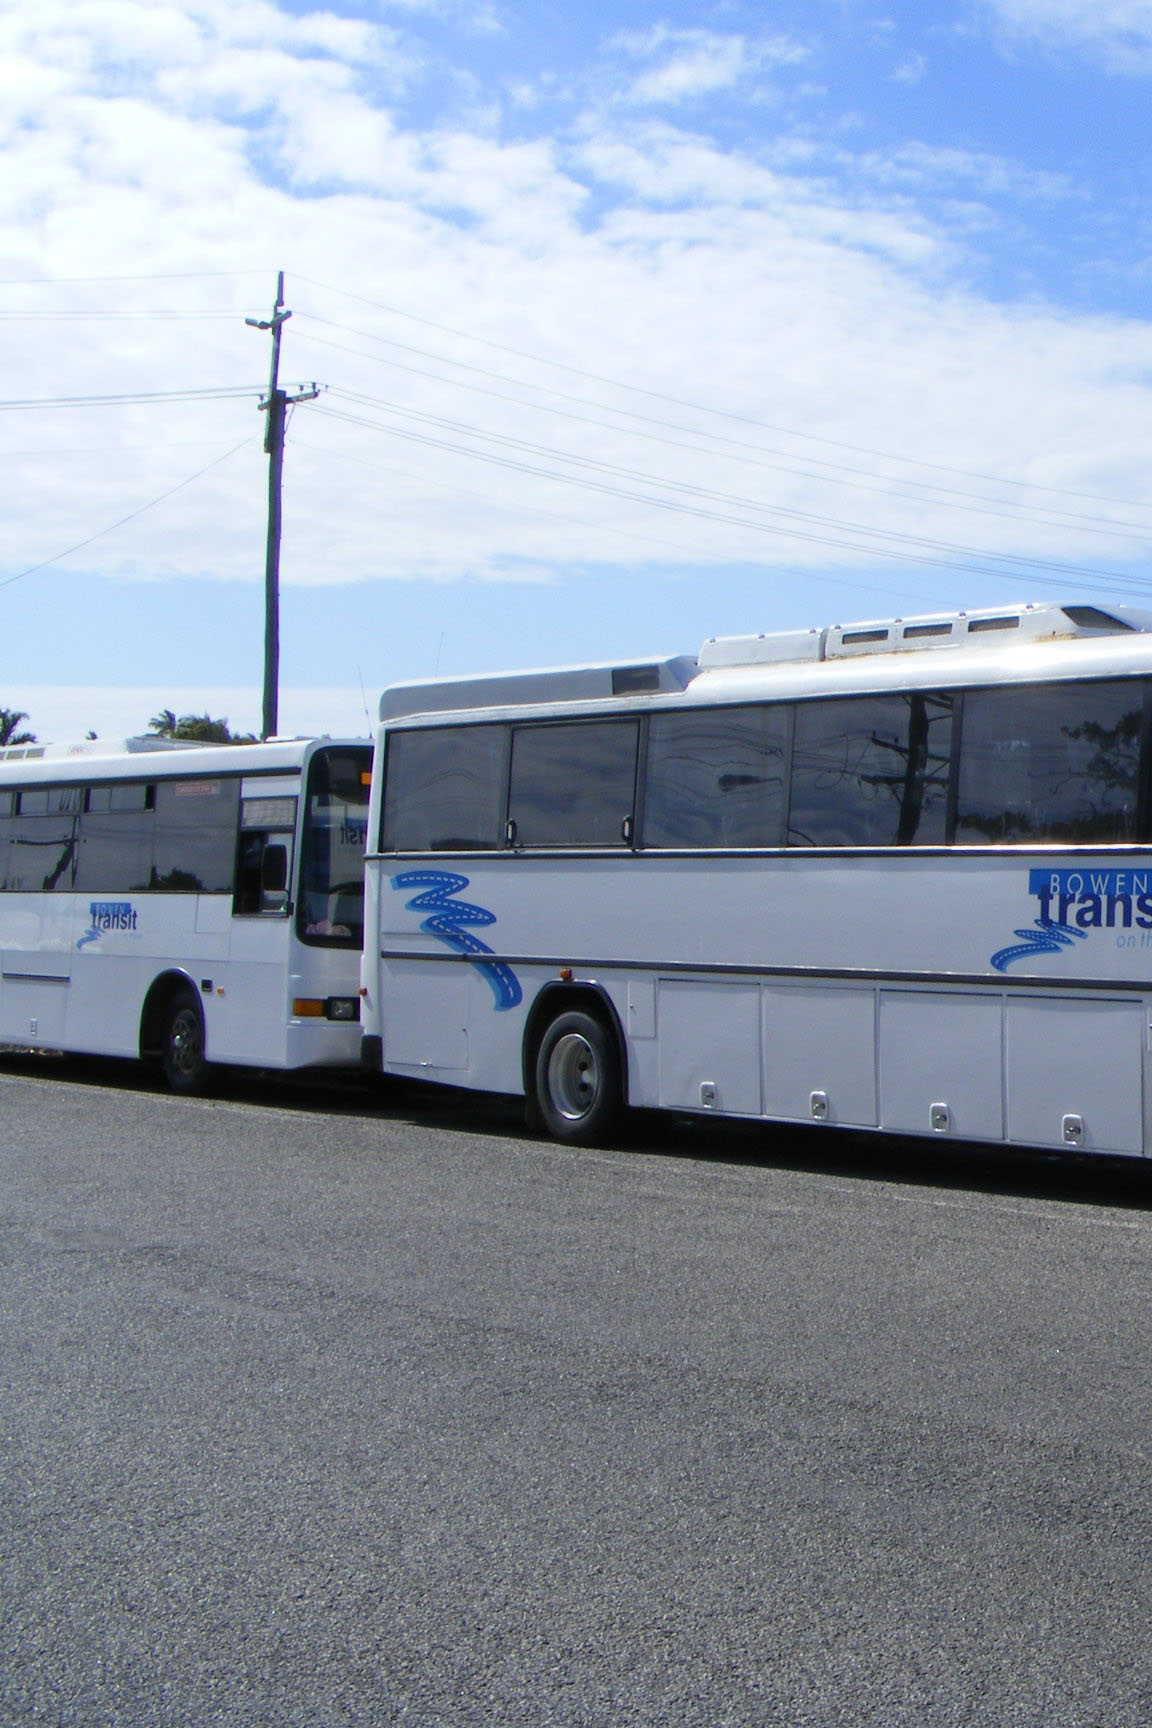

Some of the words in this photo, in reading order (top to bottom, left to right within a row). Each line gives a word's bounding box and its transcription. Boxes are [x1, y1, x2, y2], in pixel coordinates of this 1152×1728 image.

[1050, 873, 1148, 895] BOWEN
[92, 909, 137, 931] transit
[1116, 934, 1135, 948] on
